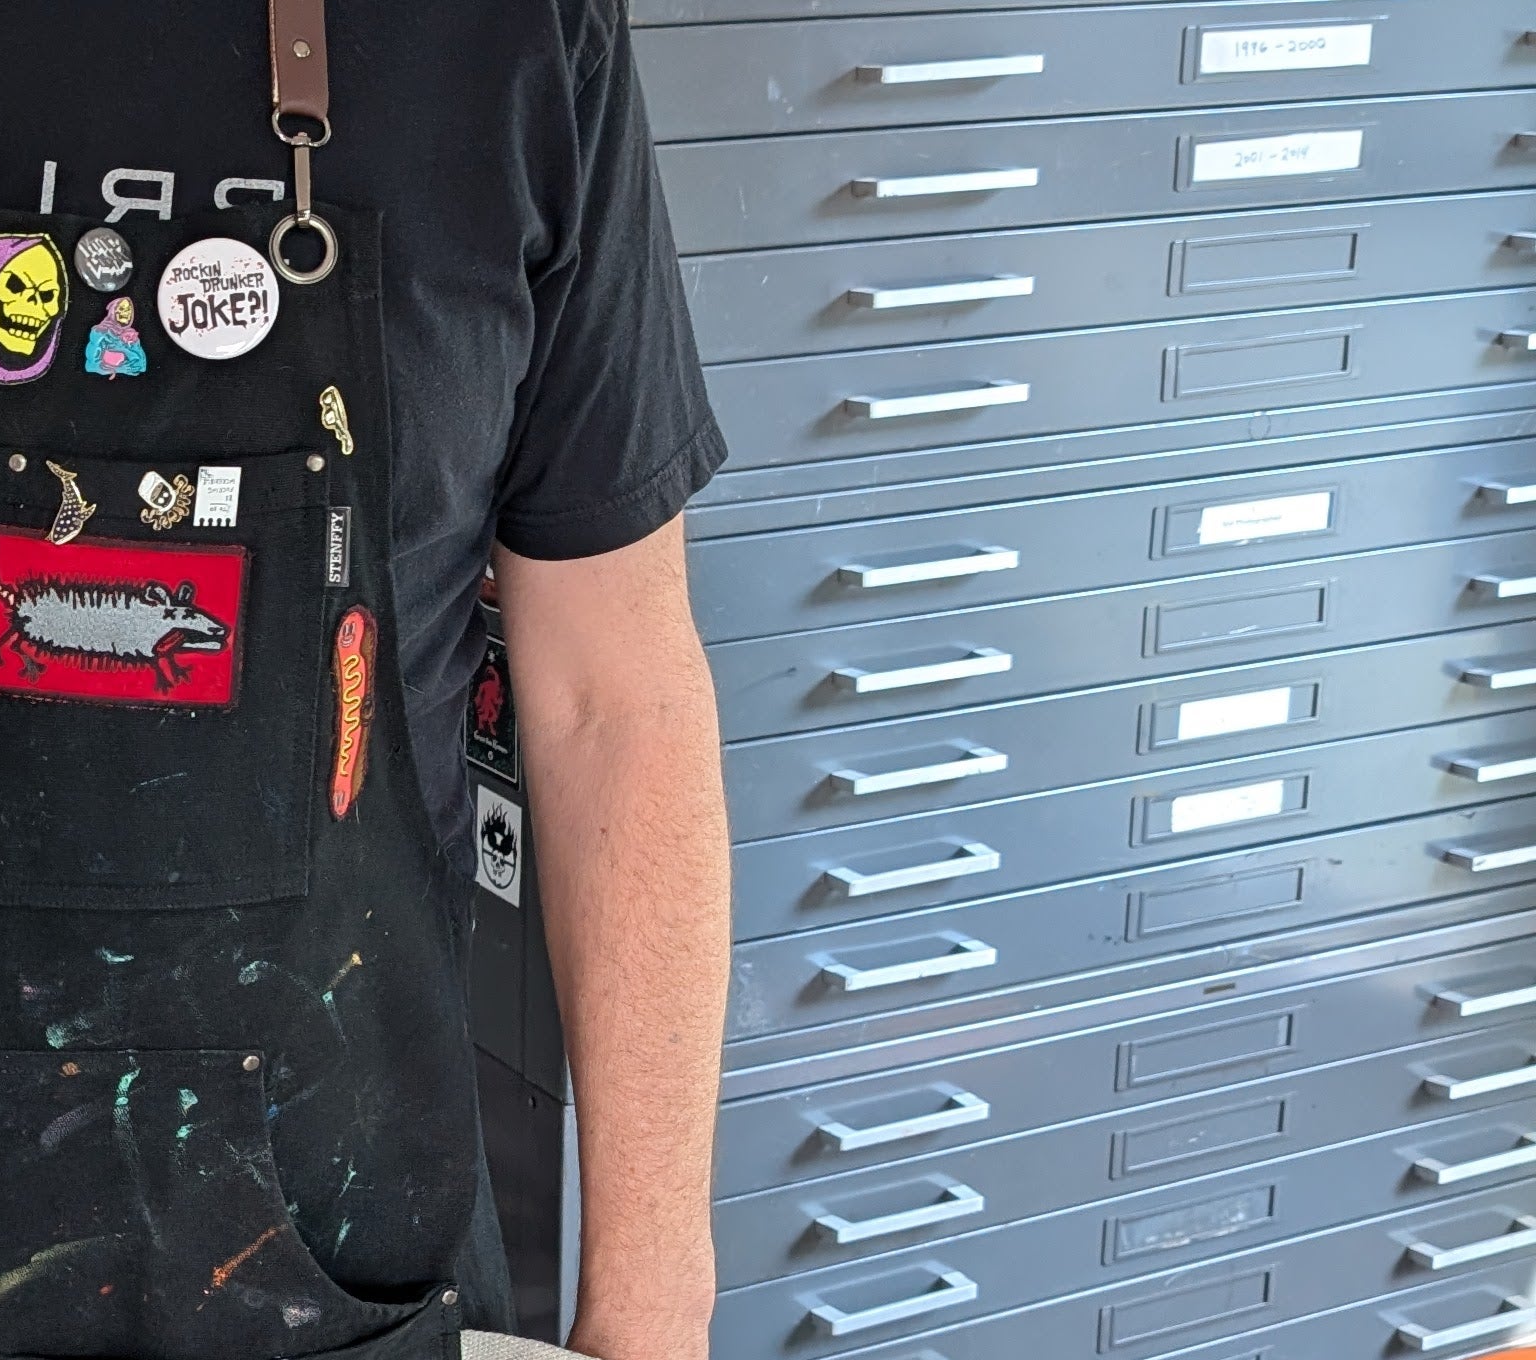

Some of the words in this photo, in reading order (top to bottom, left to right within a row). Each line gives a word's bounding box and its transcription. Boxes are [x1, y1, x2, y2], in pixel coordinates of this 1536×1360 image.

[170, 261, 222, 283] ROCKIN
[199, 272, 264, 293] DRUNKER
[169, 290, 269, 336] JOKE?!
[329, 512, 344, 583] STENFFY
